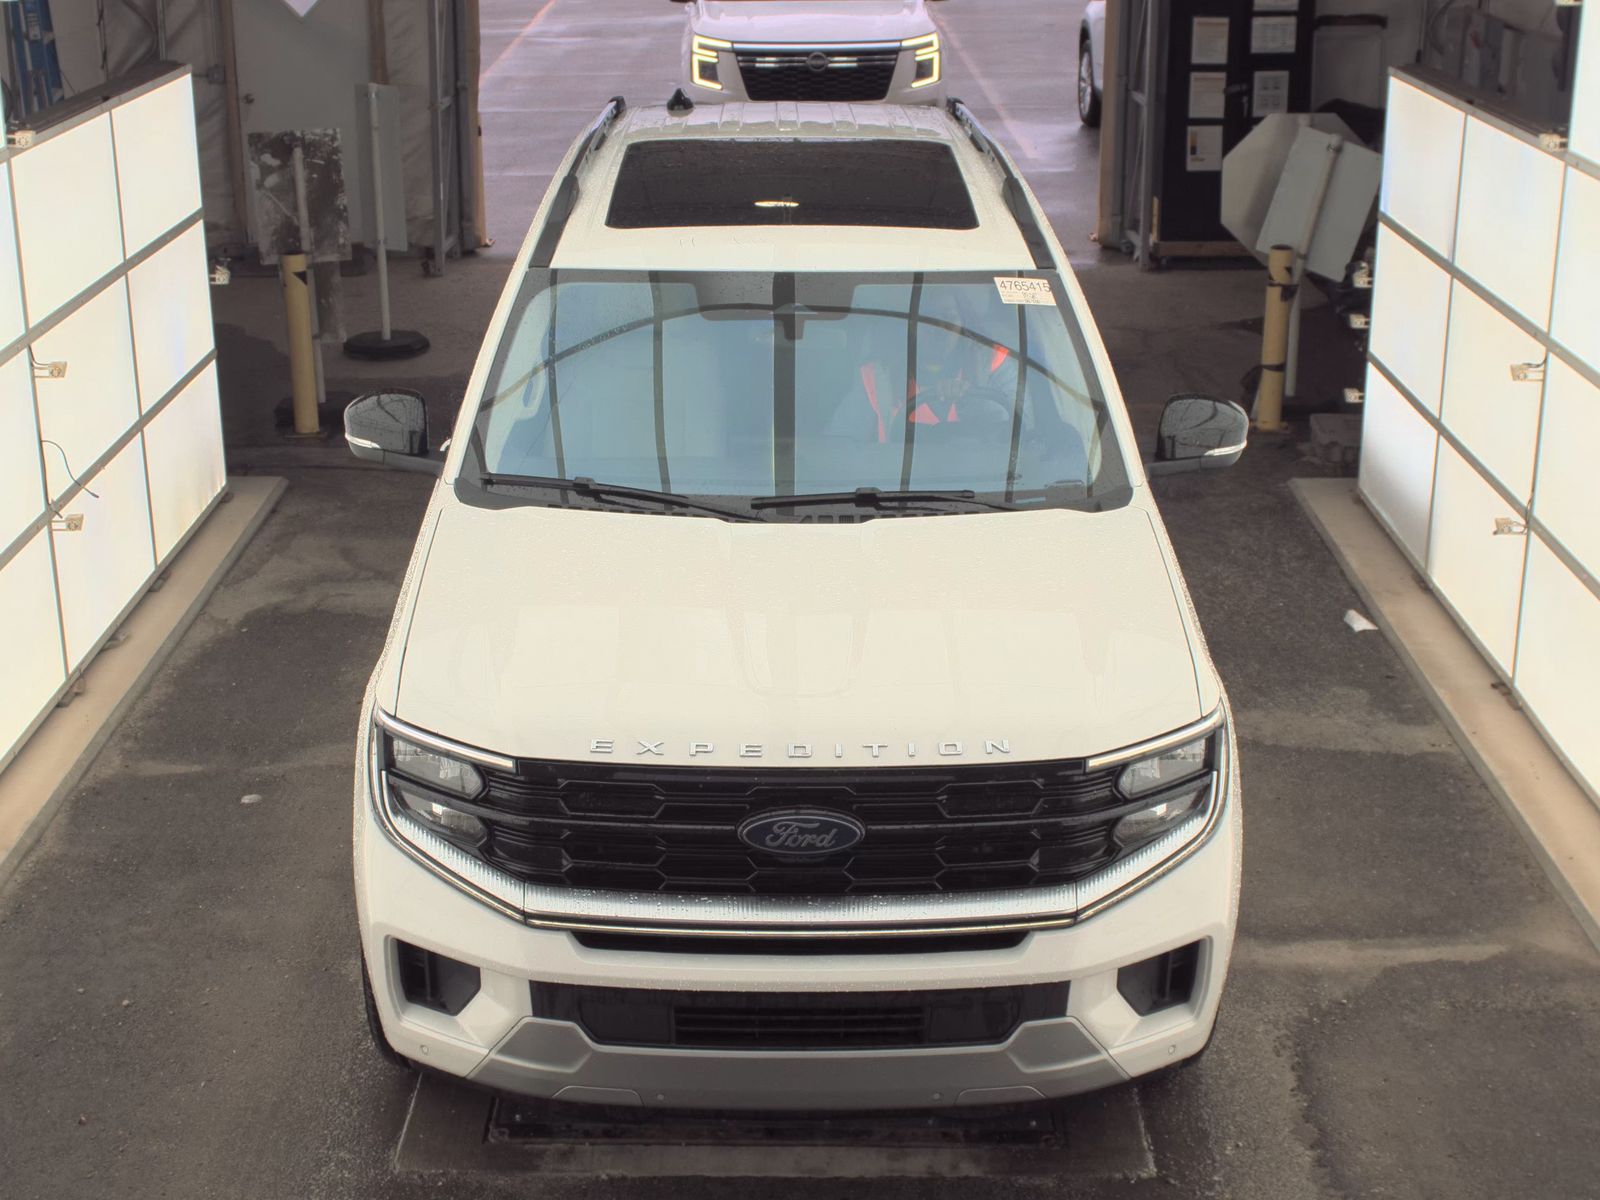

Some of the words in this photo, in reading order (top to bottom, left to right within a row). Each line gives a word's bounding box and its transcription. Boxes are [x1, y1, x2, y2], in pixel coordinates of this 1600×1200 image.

[1000, 280, 1051, 292] 4765415
[590, 739, 1010, 758] EXPEDITION
[765, 821, 838, 848] Ford
